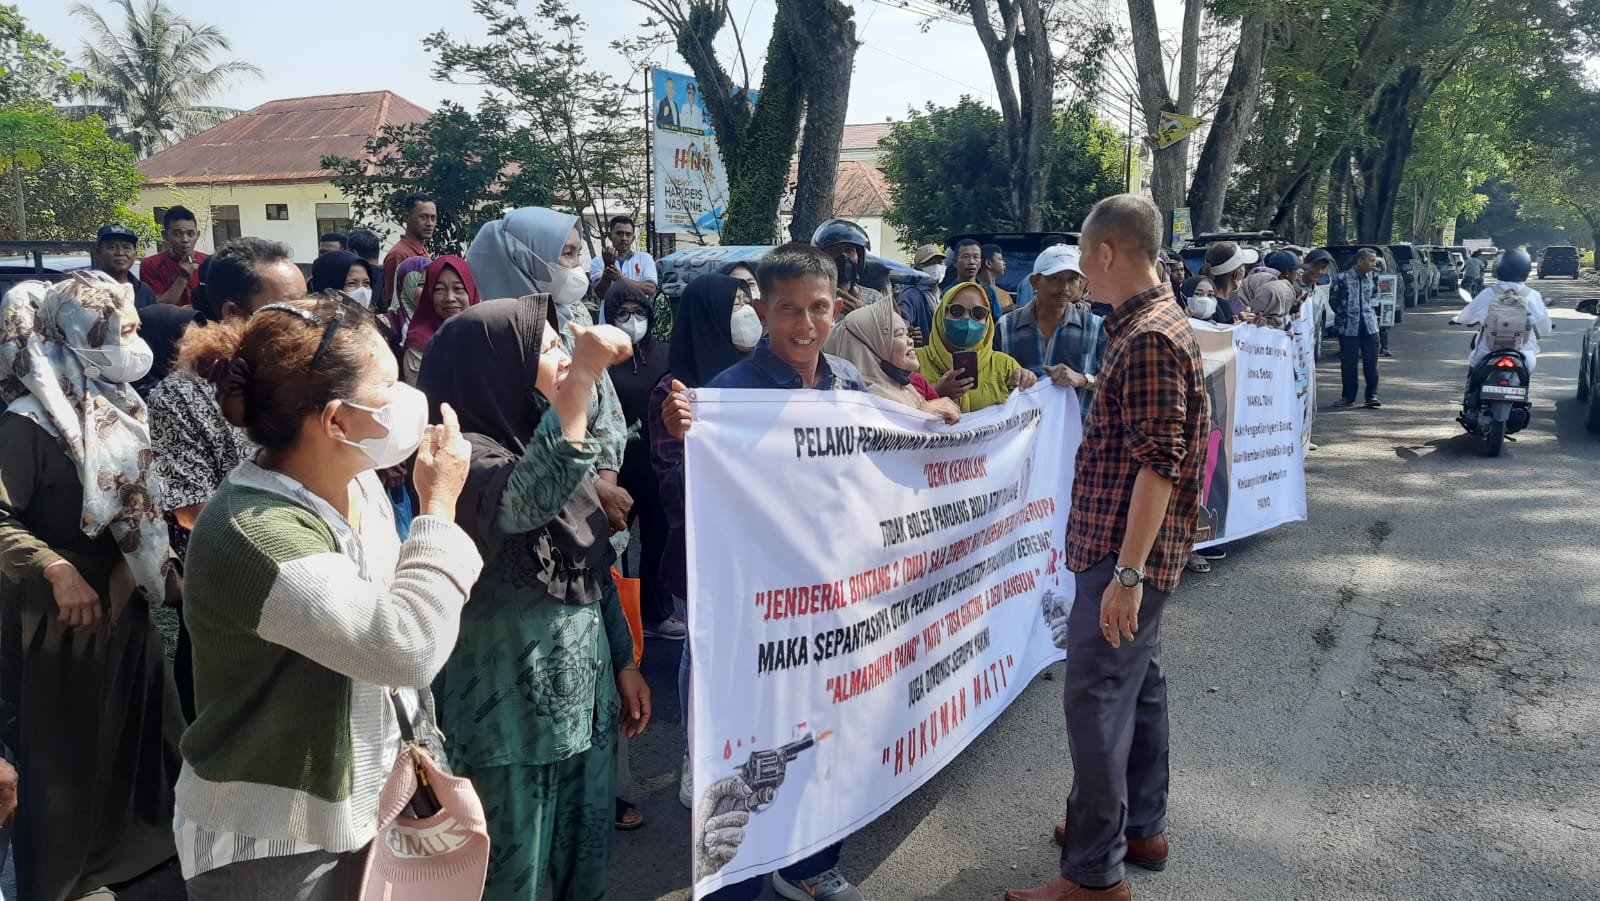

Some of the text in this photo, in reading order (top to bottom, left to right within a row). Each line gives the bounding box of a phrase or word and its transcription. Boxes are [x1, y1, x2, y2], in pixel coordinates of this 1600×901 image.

[794, 426, 854, 459] PELAKU
[879, 515, 907, 547] TIDAK
[906, 508, 934, 539] BOLEH
[933, 498, 970, 531] PANDANG
[969, 495, 988, 519] BULU
[755, 579, 847, 623] "JENDERAL
[849, 565, 891, 606] BINTANG
[893, 561, 899, 588] 2
[903, 551, 928, 585] (DUA)
[758, 636, 808, 675] MAKA
[813, 607, 891, 665] SEPANTASNYA
[891, 599, 910, 629] OTAK
[911, 585, 938, 617] PELAKU
[1017, 530, 1053, 558] BERENC
[826, 651, 893, 704] "ALMARHUM
[895, 634, 920, 672] PAINO"
[922, 621, 941, 655] YAITU
[961, 594, 984, 626] GINTING
[908, 676, 925, 708] JUGA
